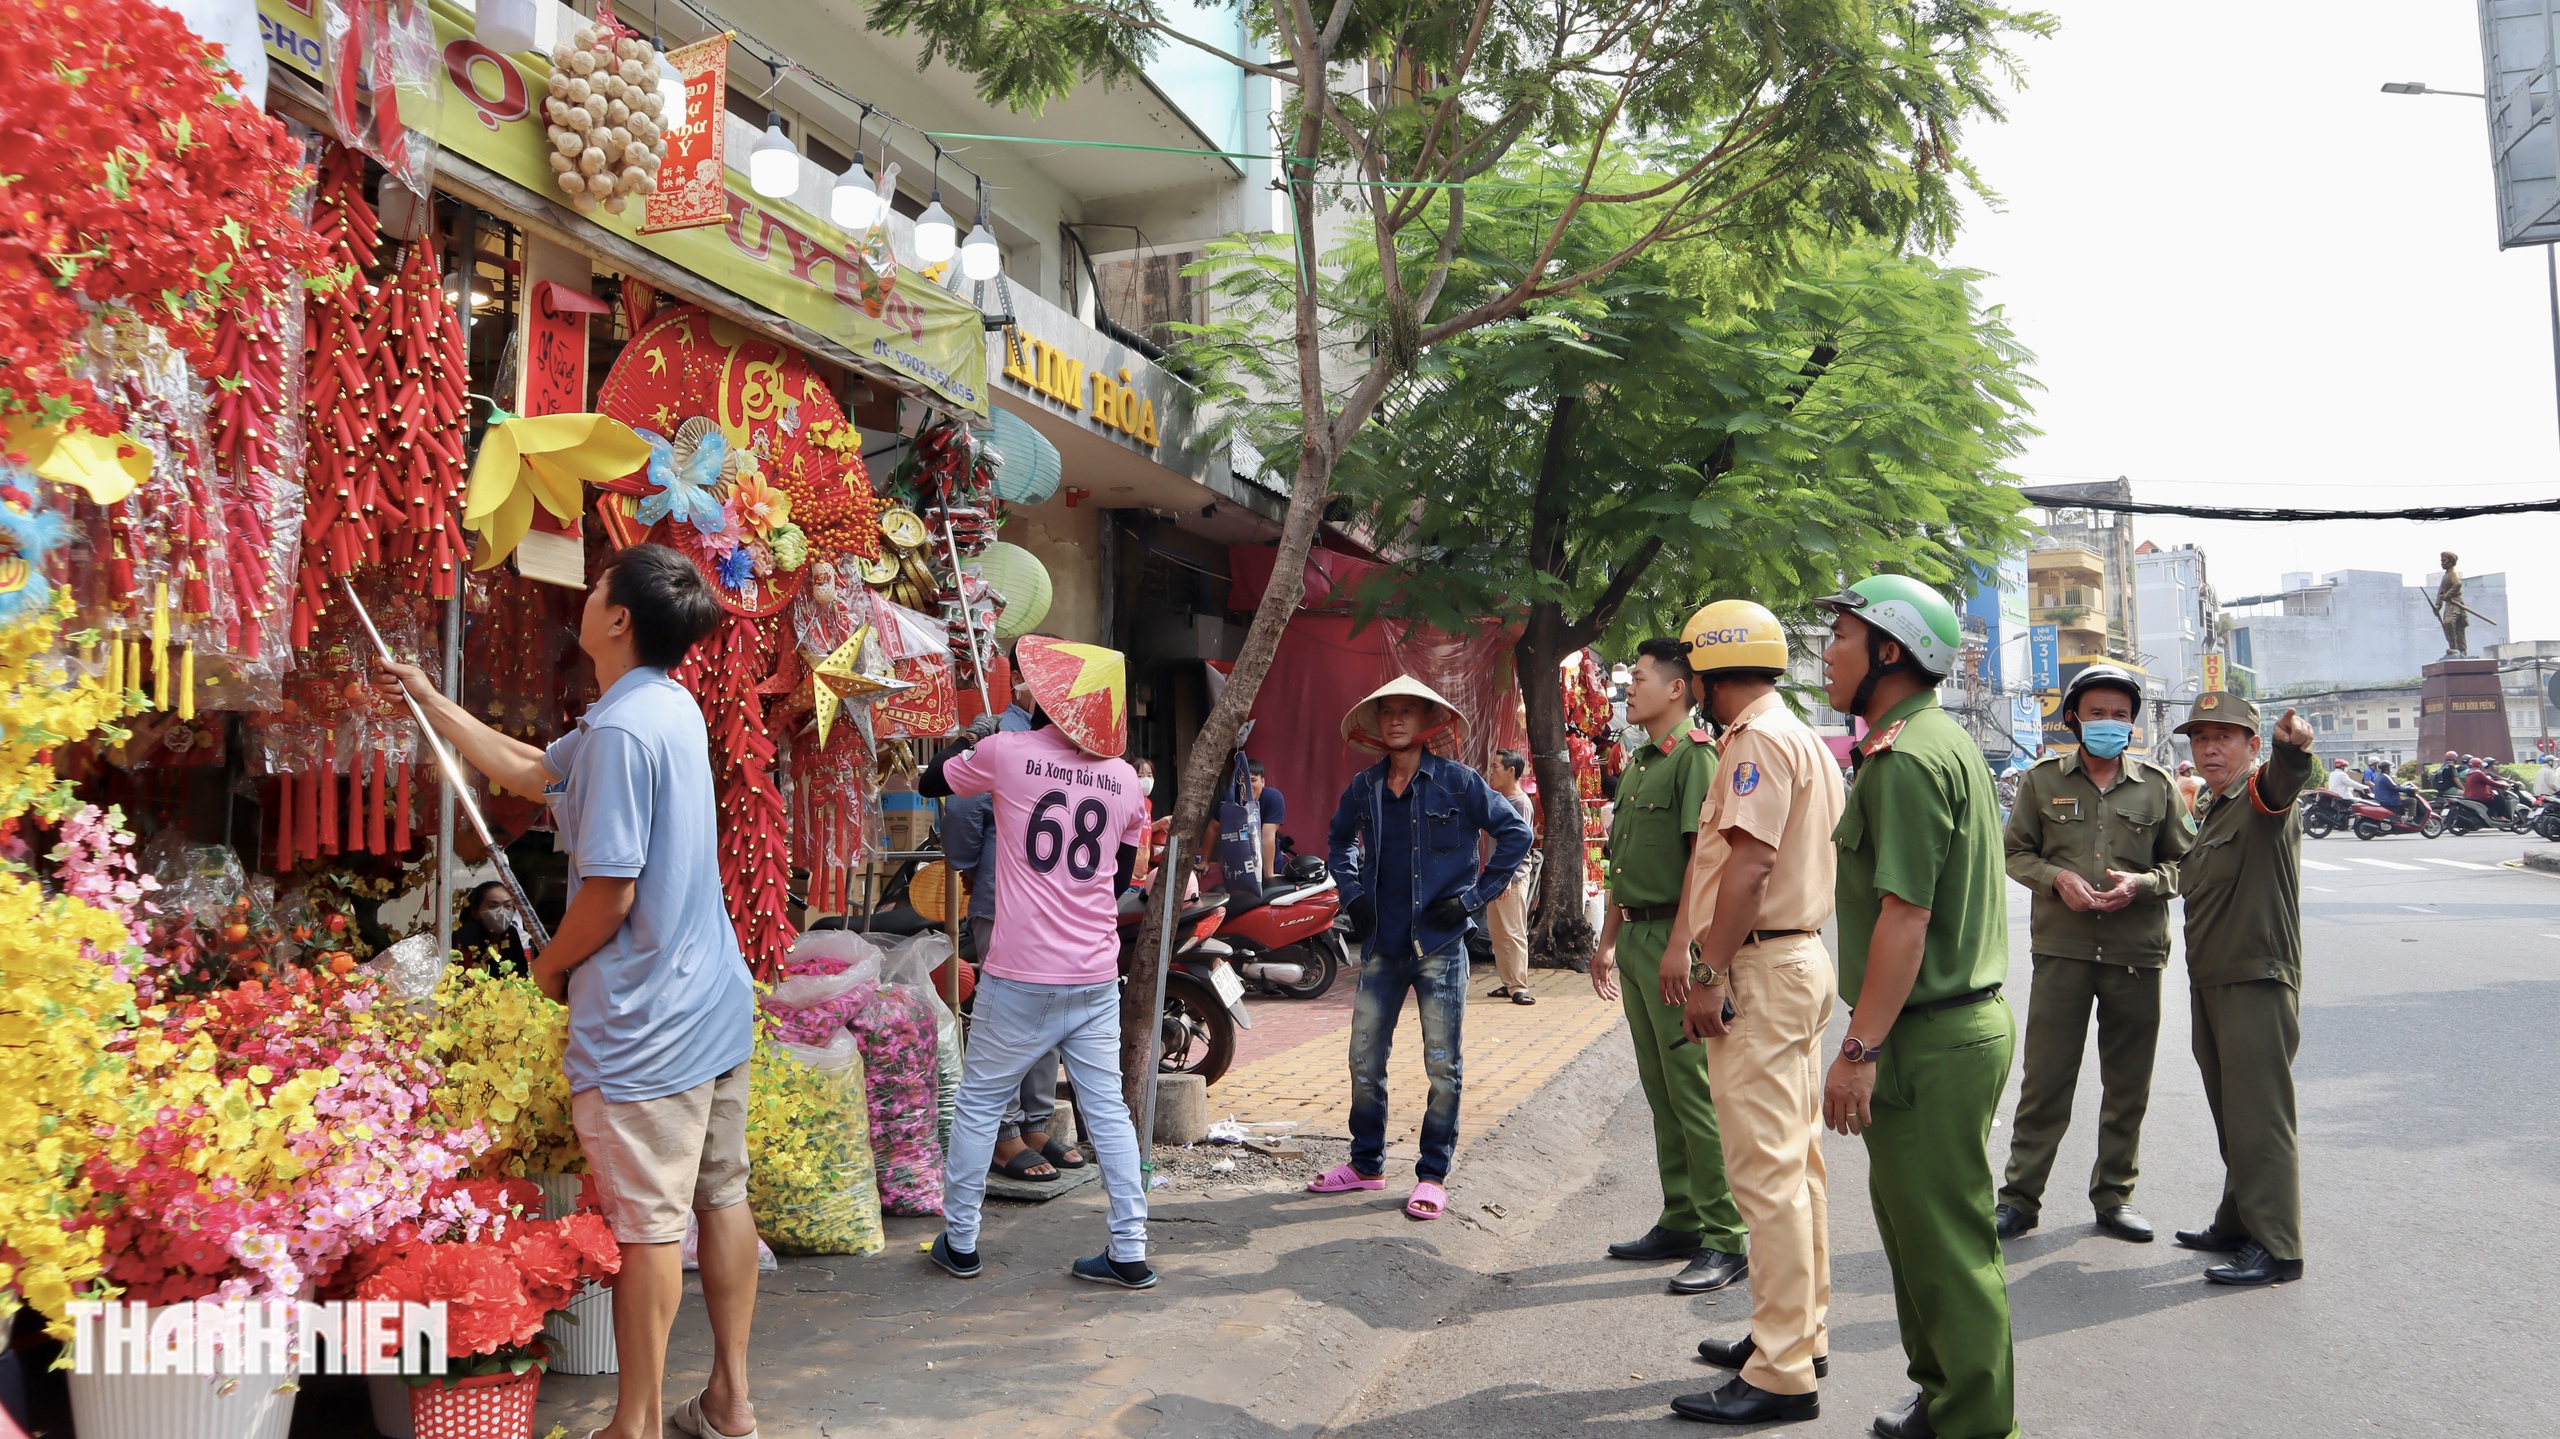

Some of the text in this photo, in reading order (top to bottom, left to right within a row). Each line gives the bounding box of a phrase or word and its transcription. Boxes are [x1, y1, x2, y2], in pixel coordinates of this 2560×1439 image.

[685, 82, 708, 100] ạn
[677, 136, 694, 157] Ý
[1004, 325, 1084, 411] KIM
[1695, 628, 1749, 648] CSGT
[2206, 655, 2219, 692] HOTE
[1025, 759, 1122, 796] Đá Xong Rồi Nhậu
[1024, 788, 1109, 883] 68
[1279, 915, 1315, 927] LEAD
